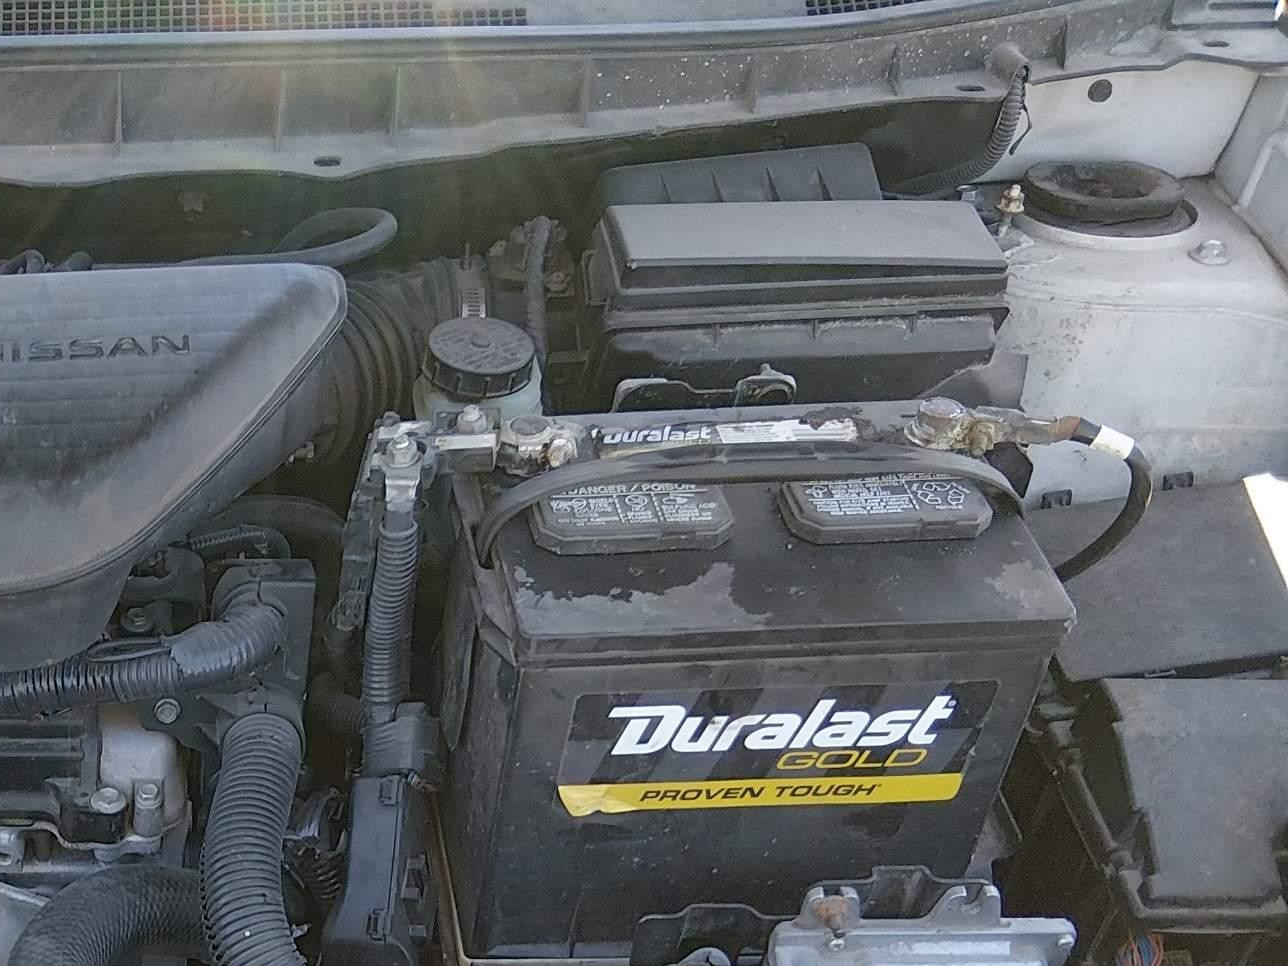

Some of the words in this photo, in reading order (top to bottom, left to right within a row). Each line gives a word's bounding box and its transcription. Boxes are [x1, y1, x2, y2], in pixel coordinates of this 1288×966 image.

[608, 695, 955, 755] Duralast
[776, 749, 929, 770] GOLD
[639, 786, 765, 802] PROVEN
[775, 784, 877, 798] TOUGH
